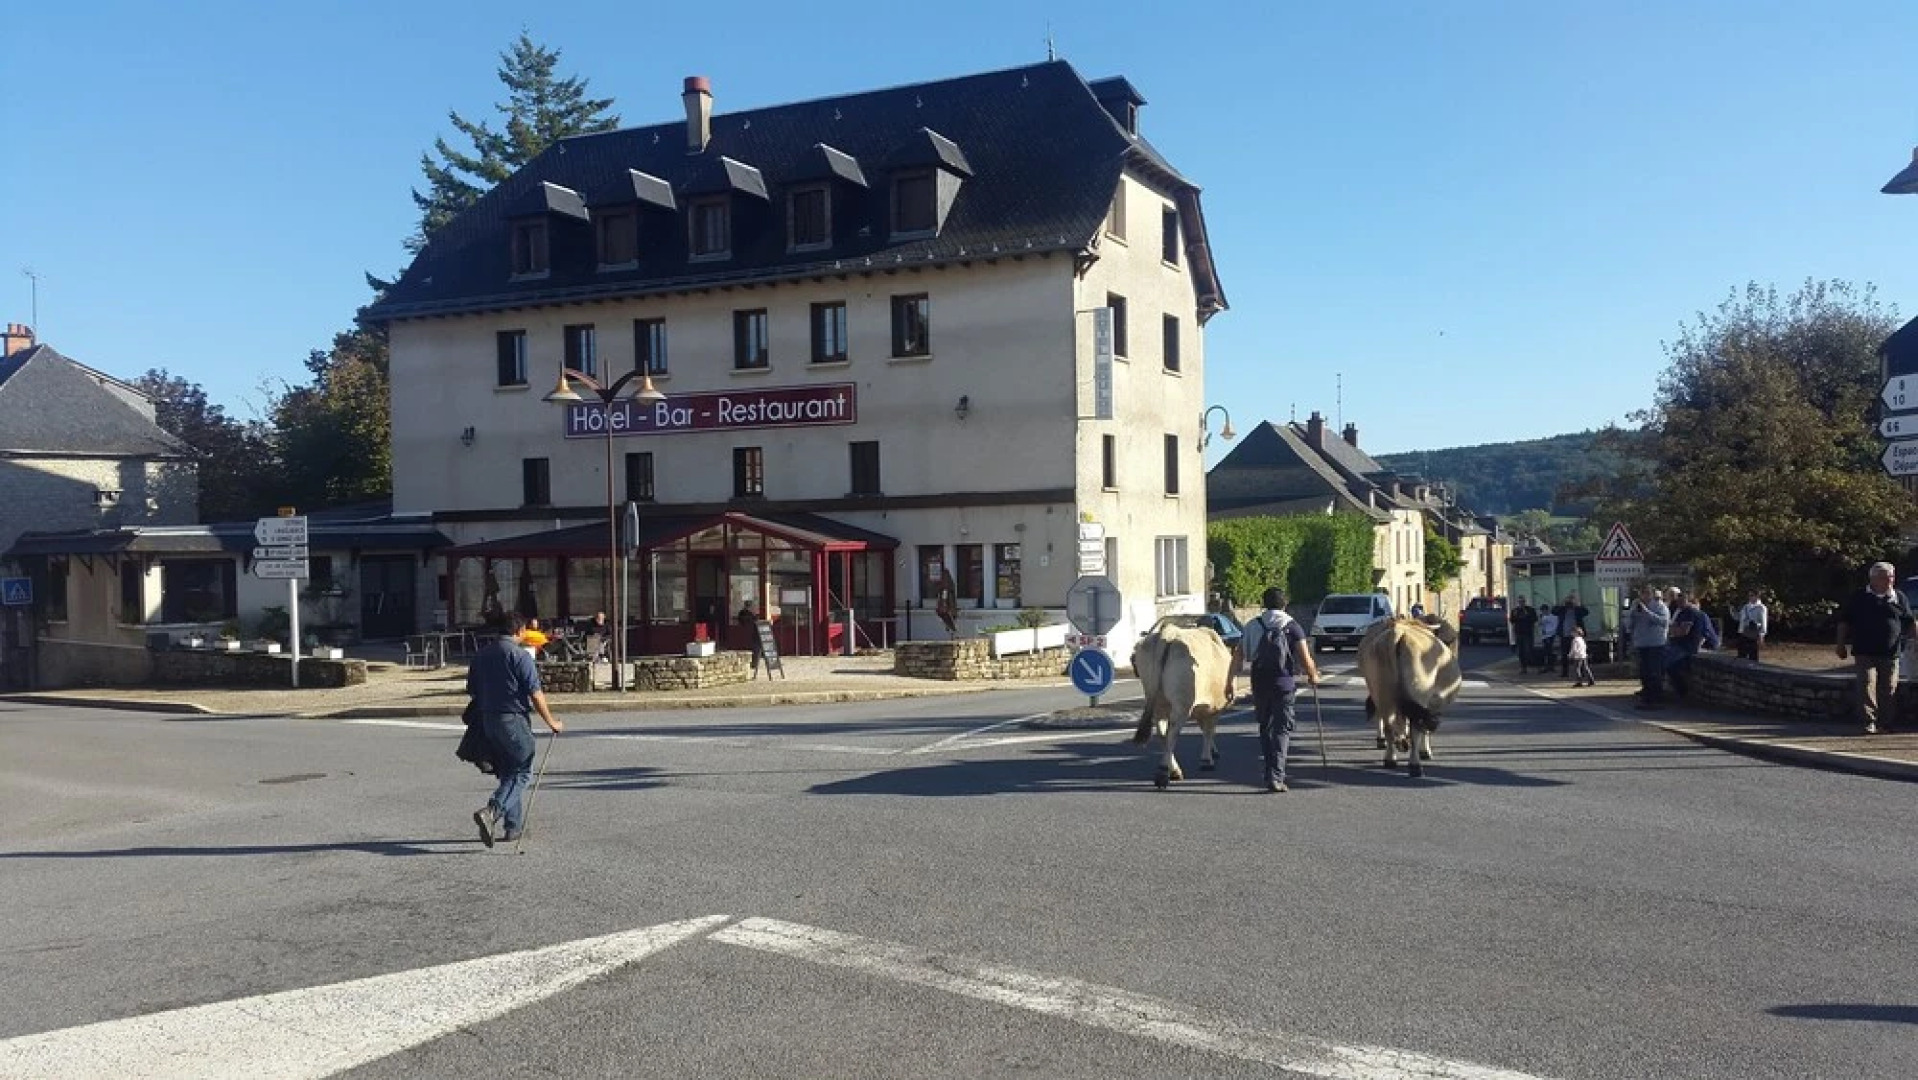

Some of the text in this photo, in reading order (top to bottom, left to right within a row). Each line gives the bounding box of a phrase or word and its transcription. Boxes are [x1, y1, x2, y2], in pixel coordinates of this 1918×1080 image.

[573, 404, 630, 430] Hôtel
[655, 402, 694, 426] Bar
[719, 392, 846, 423] Restaurant
